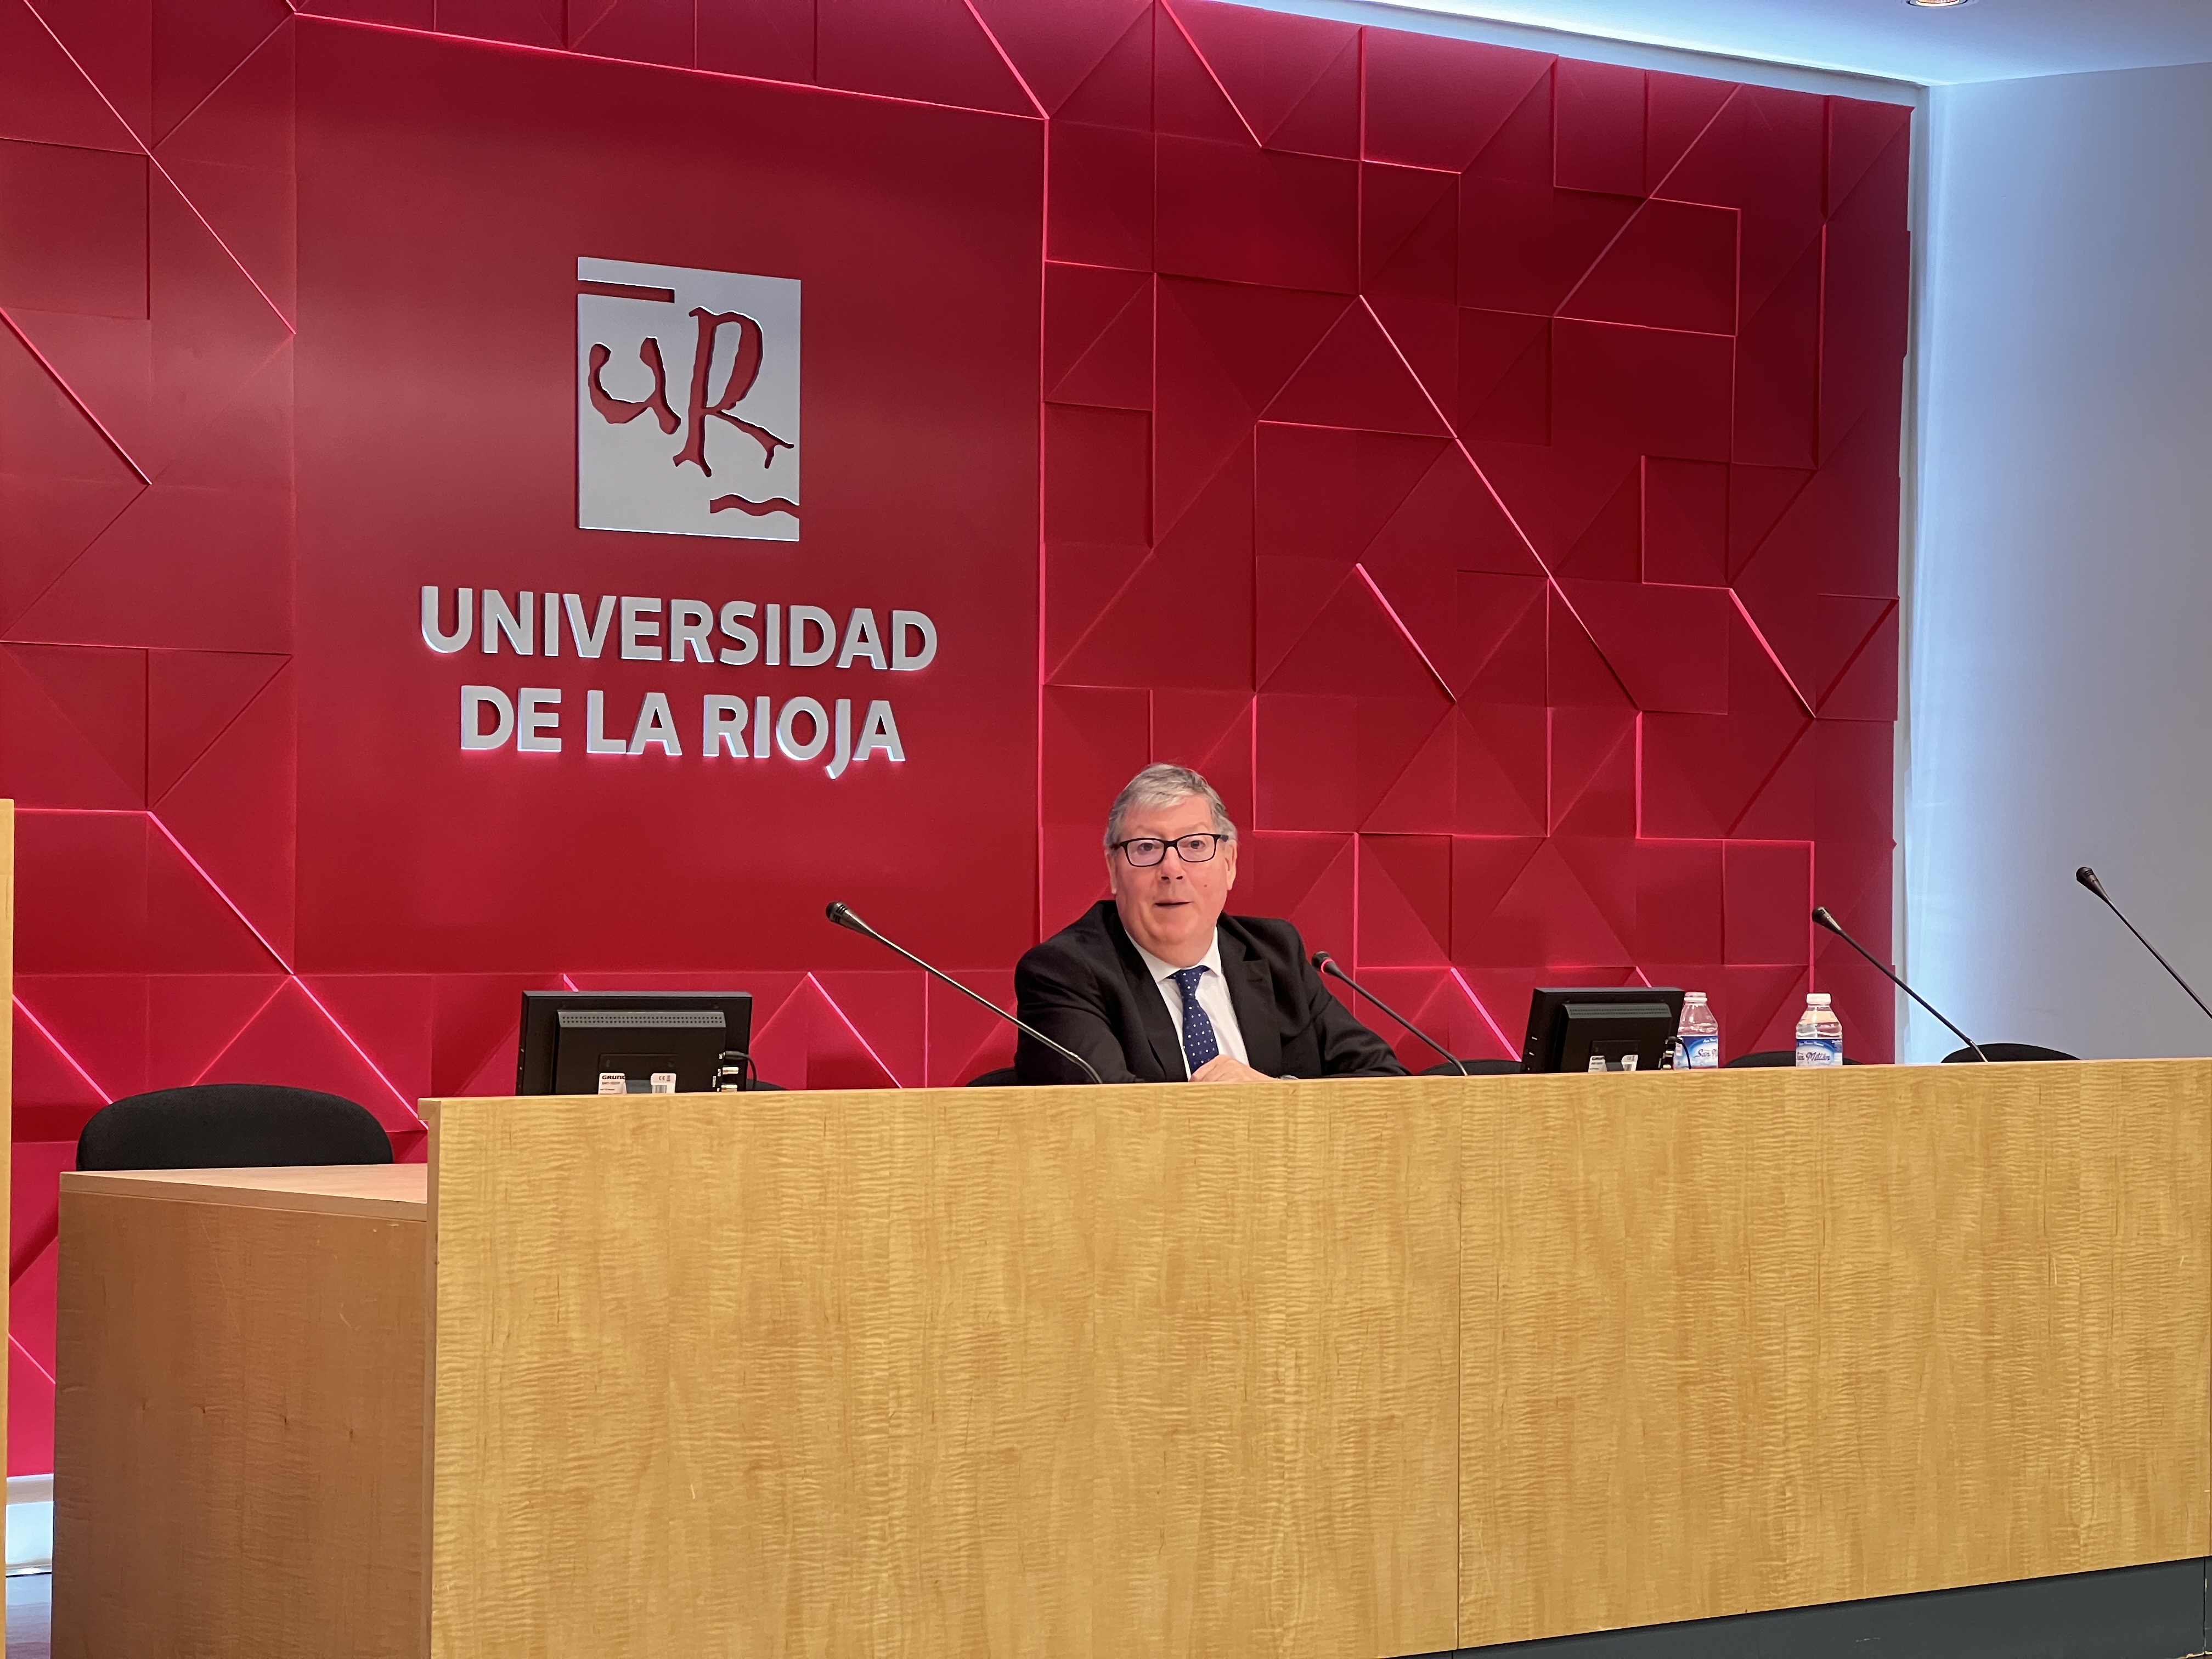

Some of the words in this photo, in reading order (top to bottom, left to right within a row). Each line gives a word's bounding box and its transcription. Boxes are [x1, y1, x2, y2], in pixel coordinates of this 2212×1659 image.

[421, 585, 938, 672] UNIVERSIDAD
[460, 685, 562, 753] DE
[586, 690, 683, 757] LA
[703, 694, 906, 780] RIOJA
